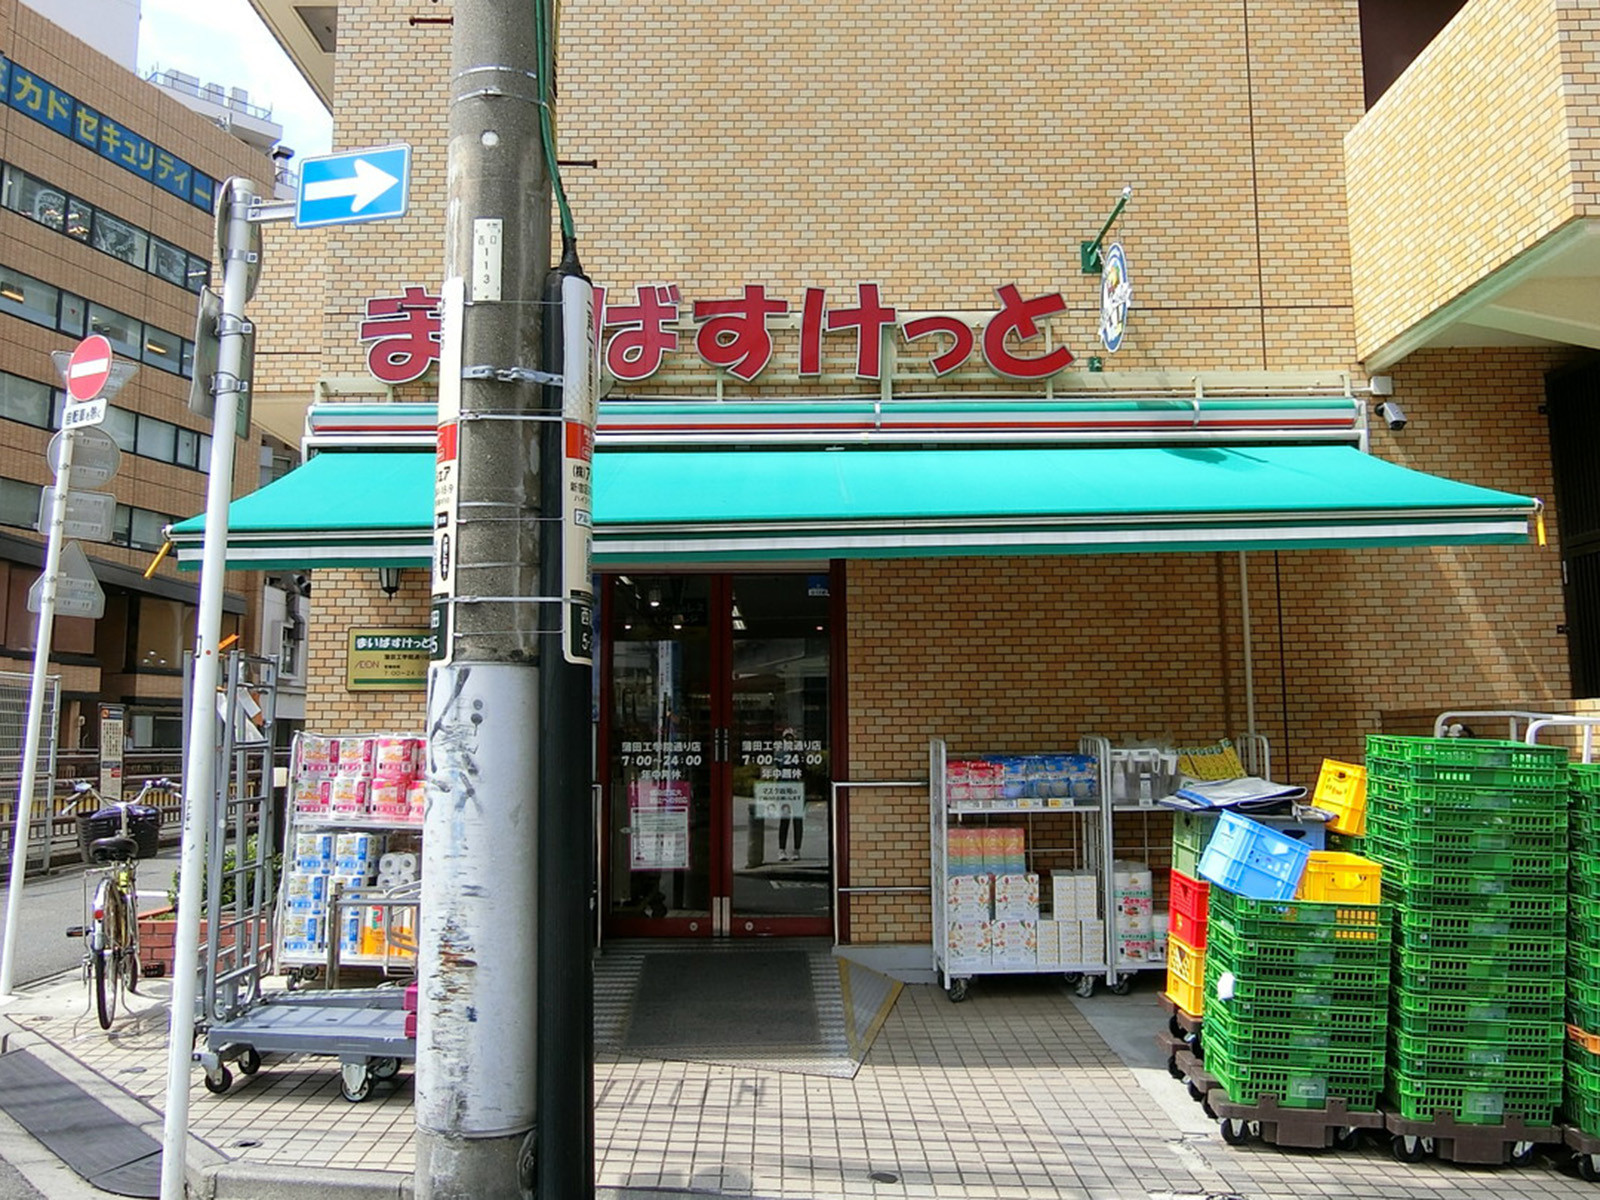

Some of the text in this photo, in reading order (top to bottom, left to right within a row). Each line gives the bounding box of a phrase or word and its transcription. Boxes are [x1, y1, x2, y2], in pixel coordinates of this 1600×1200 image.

[359, 282, 1076, 386] まばすけっと
[356, 637, 431, 649] まいばすけっと
[741, 741, 822, 751] 蒲田工学院通り店
